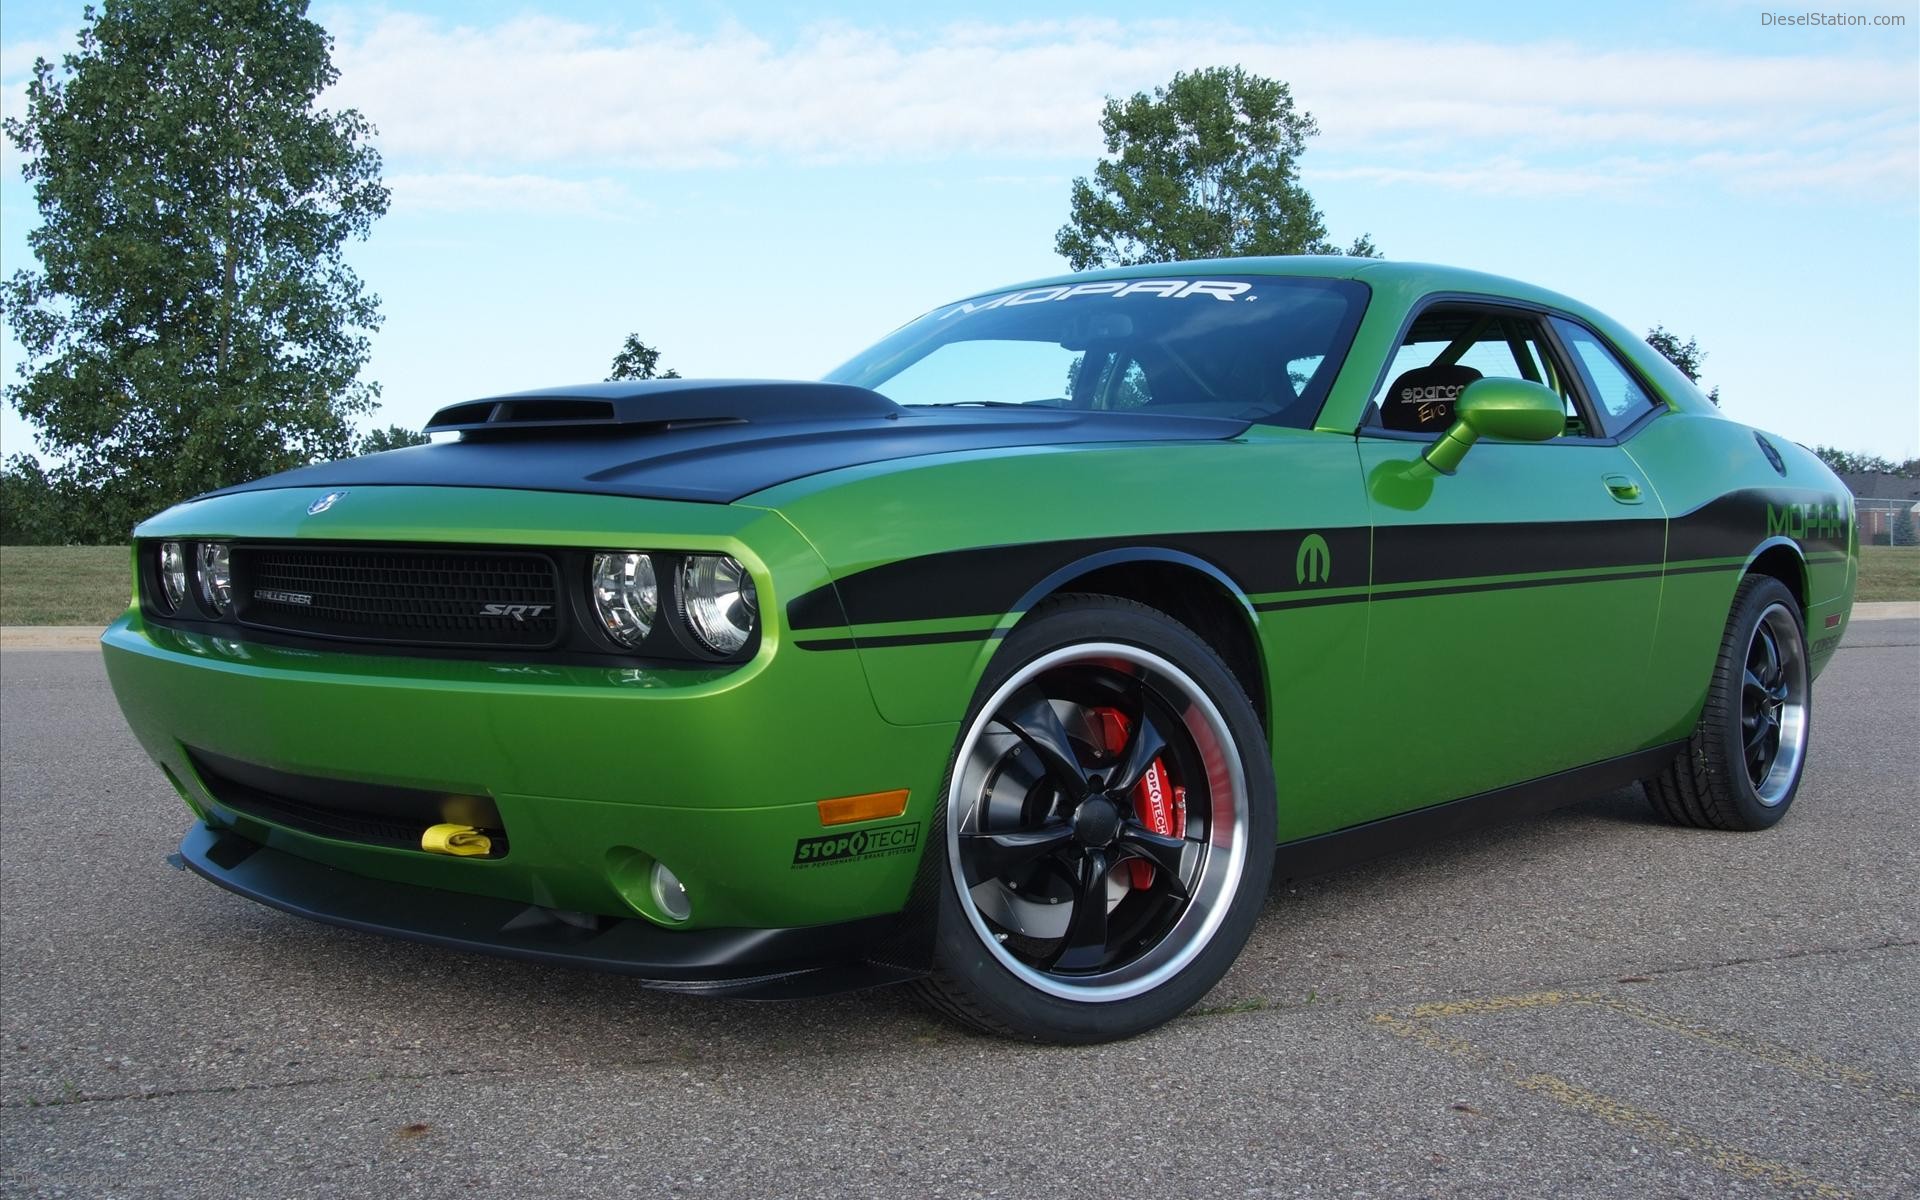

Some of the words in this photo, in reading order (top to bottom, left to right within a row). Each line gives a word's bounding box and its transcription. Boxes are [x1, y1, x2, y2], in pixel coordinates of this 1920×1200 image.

[937, 280, 1253, 320] MOPAR
[1766, 502, 1842, 539] MOPAR
[480, 604, 552, 621] SRT
